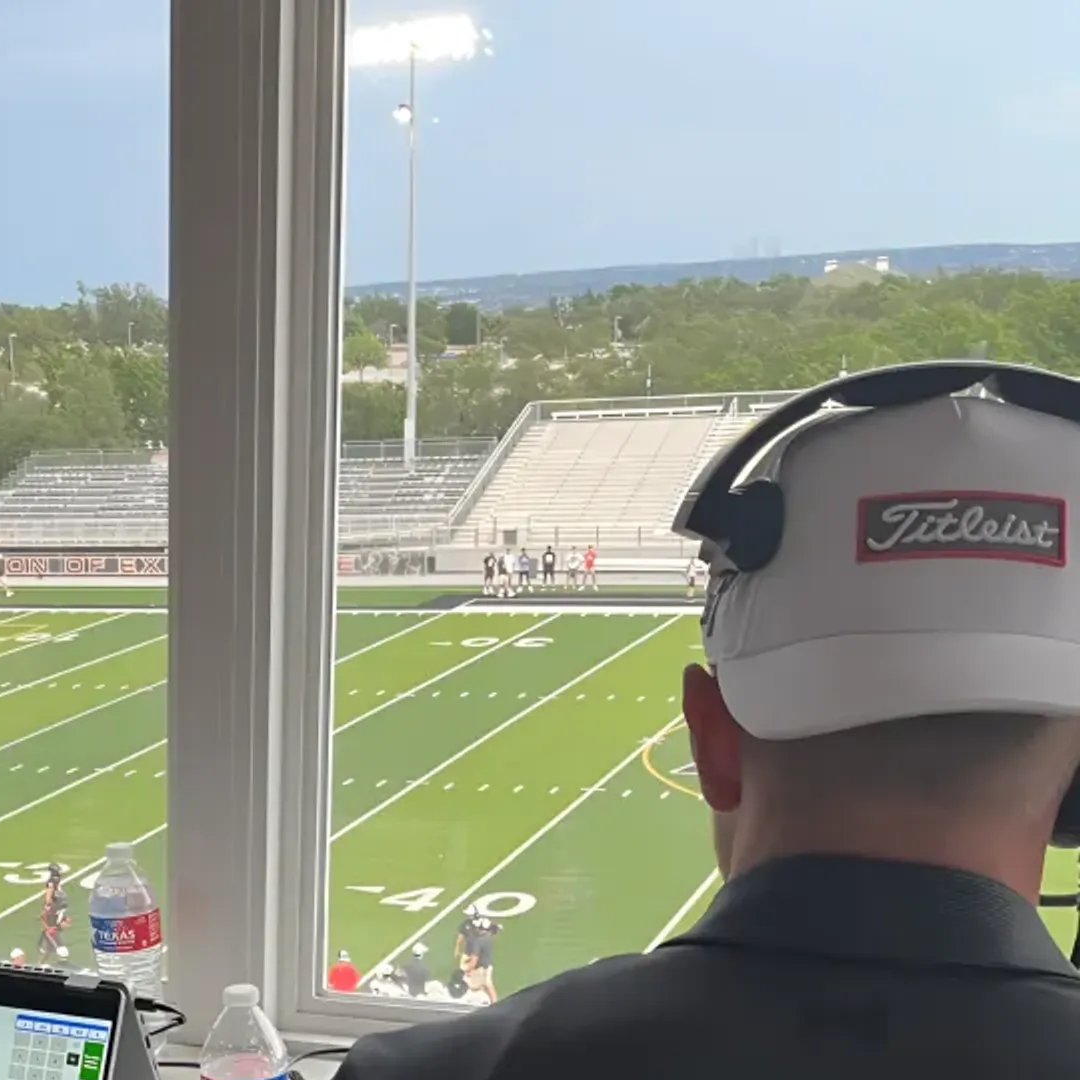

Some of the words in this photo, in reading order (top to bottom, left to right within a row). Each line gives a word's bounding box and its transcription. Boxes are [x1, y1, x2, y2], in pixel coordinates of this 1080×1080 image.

[866, 498, 1059, 551] Titleist
[64, 557, 106, 574] OF
[379, 886, 538, 917] 40
